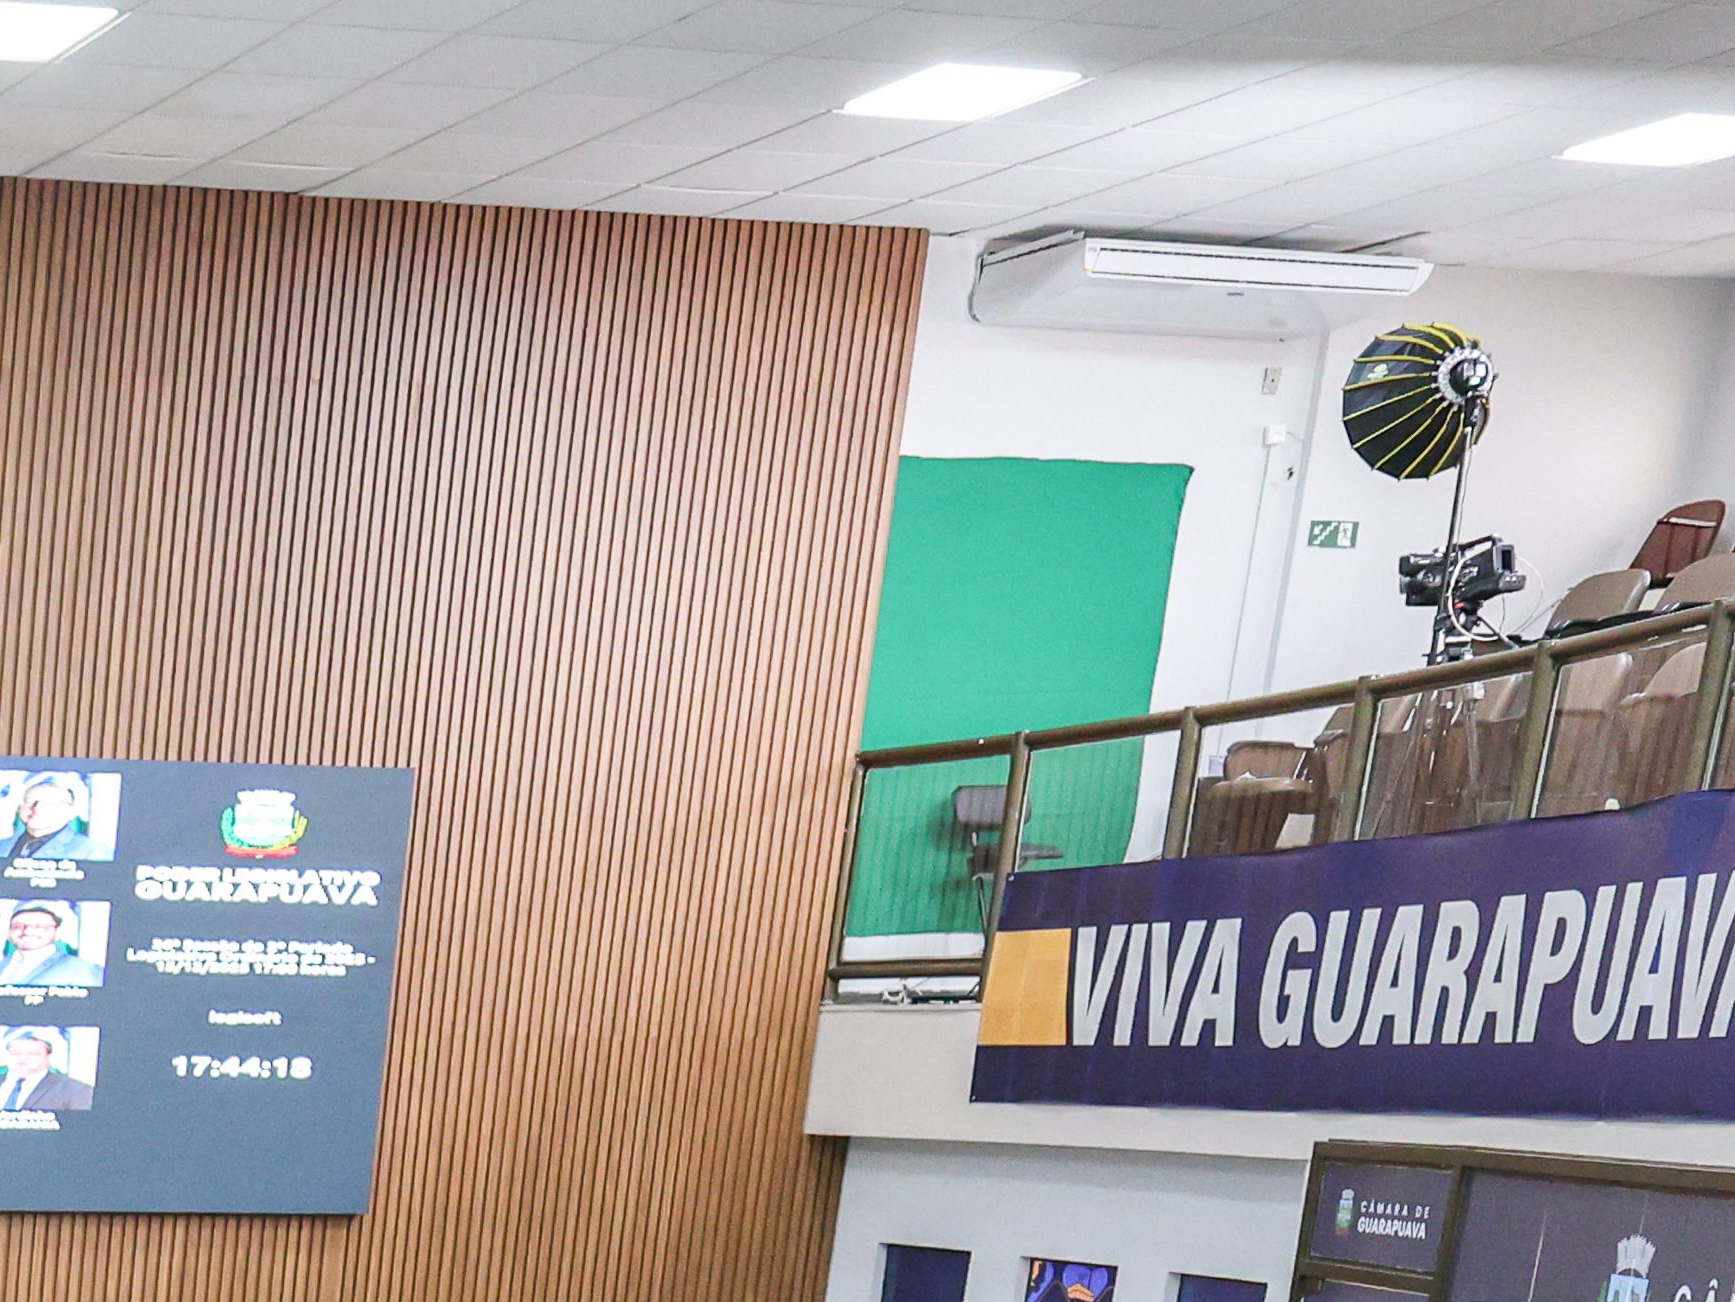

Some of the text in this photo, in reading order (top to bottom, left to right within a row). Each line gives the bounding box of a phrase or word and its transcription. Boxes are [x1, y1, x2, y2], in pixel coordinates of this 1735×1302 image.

[135, 864, 382, 887] PODER LEGISLATIVO
[134, 879, 378, 906] GUARAPUAVA
[1068, 916, 1243, 1047] VIVA
[172, 1055, 313, 1079] 17:44:18
[1415, 1205, 1430, 1219] DE
[1357, 1216, 1426, 1240] GUARAPUAVA
